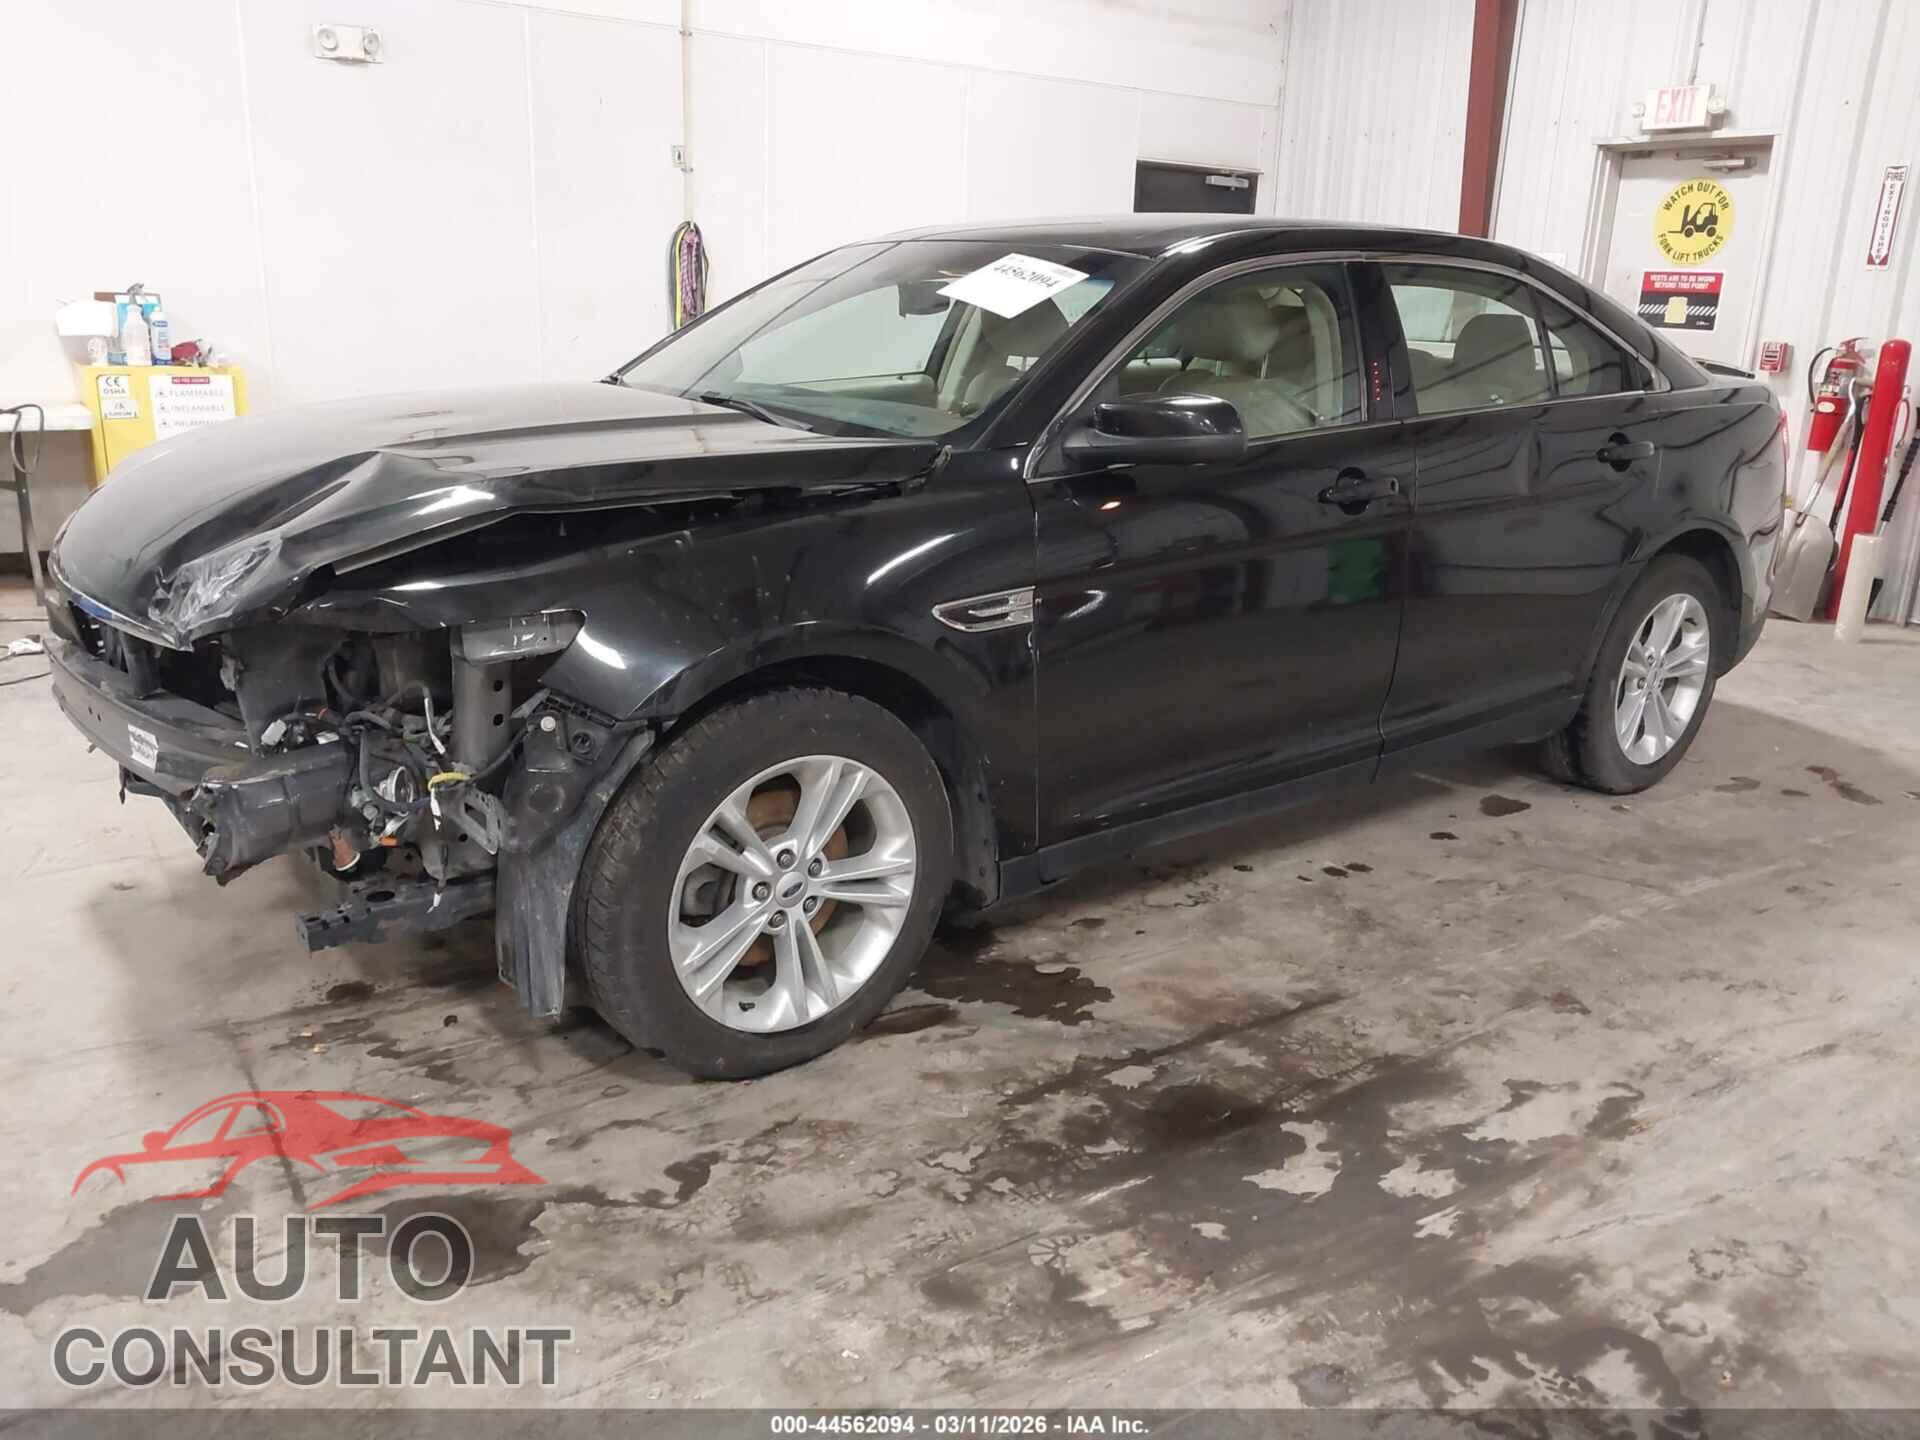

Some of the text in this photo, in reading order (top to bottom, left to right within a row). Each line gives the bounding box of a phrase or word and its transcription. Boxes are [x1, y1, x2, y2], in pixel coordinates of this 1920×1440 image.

[1654, 87, 1696, 124] EXIT
[1886, 171, 1905, 181] FIRE
[1663, 181, 1730, 211] WATCH OUT FOR
[1875, 183, 1895, 260] EXTINGUISHER
[1658, 233, 1724, 262] FORK LIFT TRUCKS
